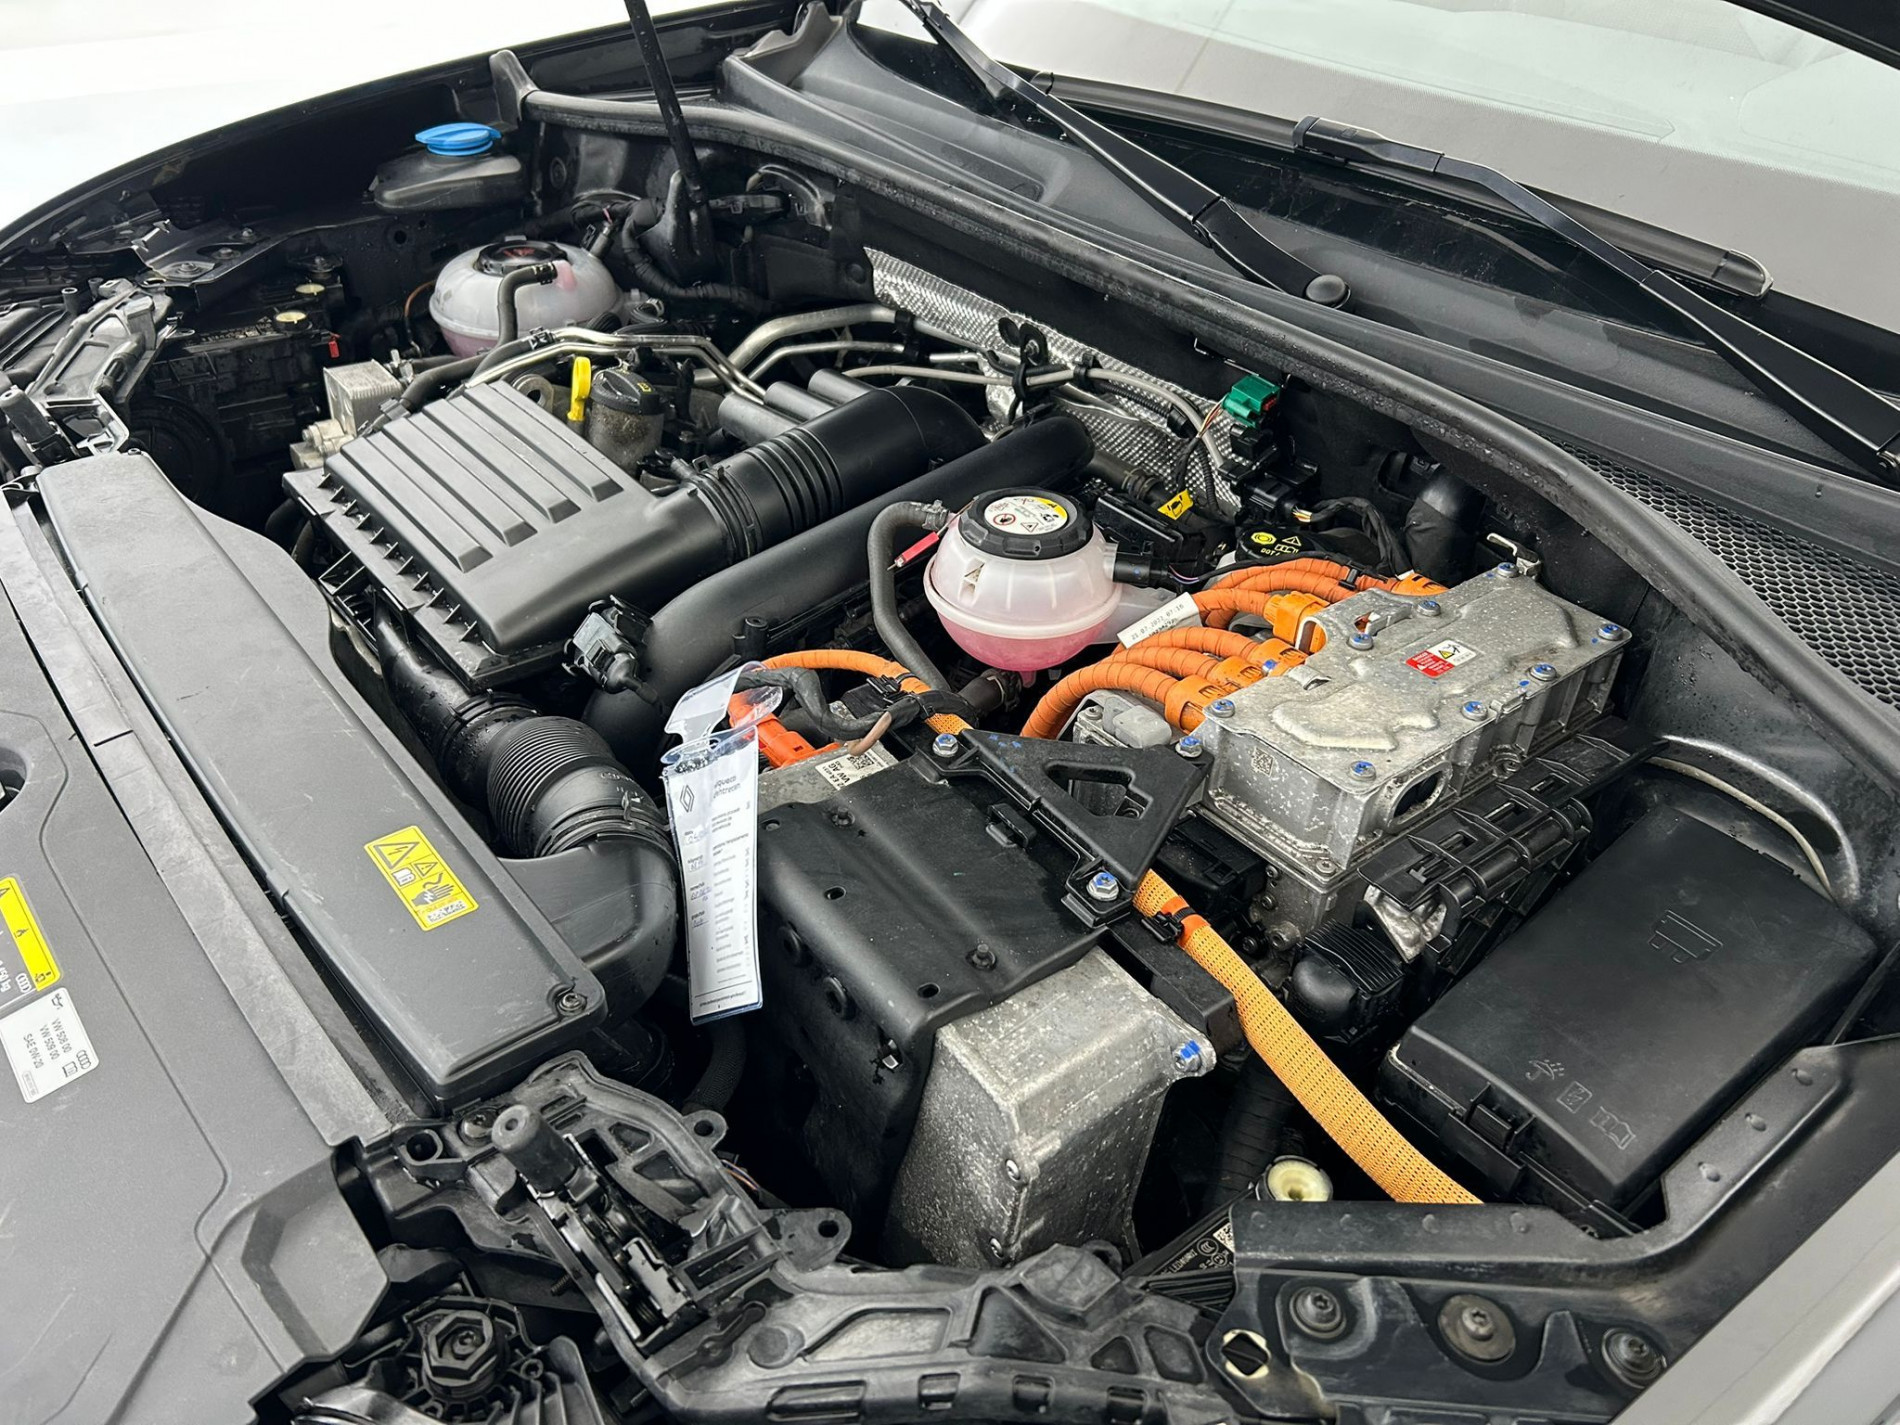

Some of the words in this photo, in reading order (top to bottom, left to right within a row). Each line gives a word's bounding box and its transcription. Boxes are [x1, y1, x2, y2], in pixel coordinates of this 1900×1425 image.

[1261, 548, 1275, 556] DOT
[828, 762, 840, 772] AG
[837, 773, 850, 783] VW
[39, 1024, 50, 1038] VW
[51, 1018, 62, 1032] VW
[23, 1033, 36, 1048] SAE
